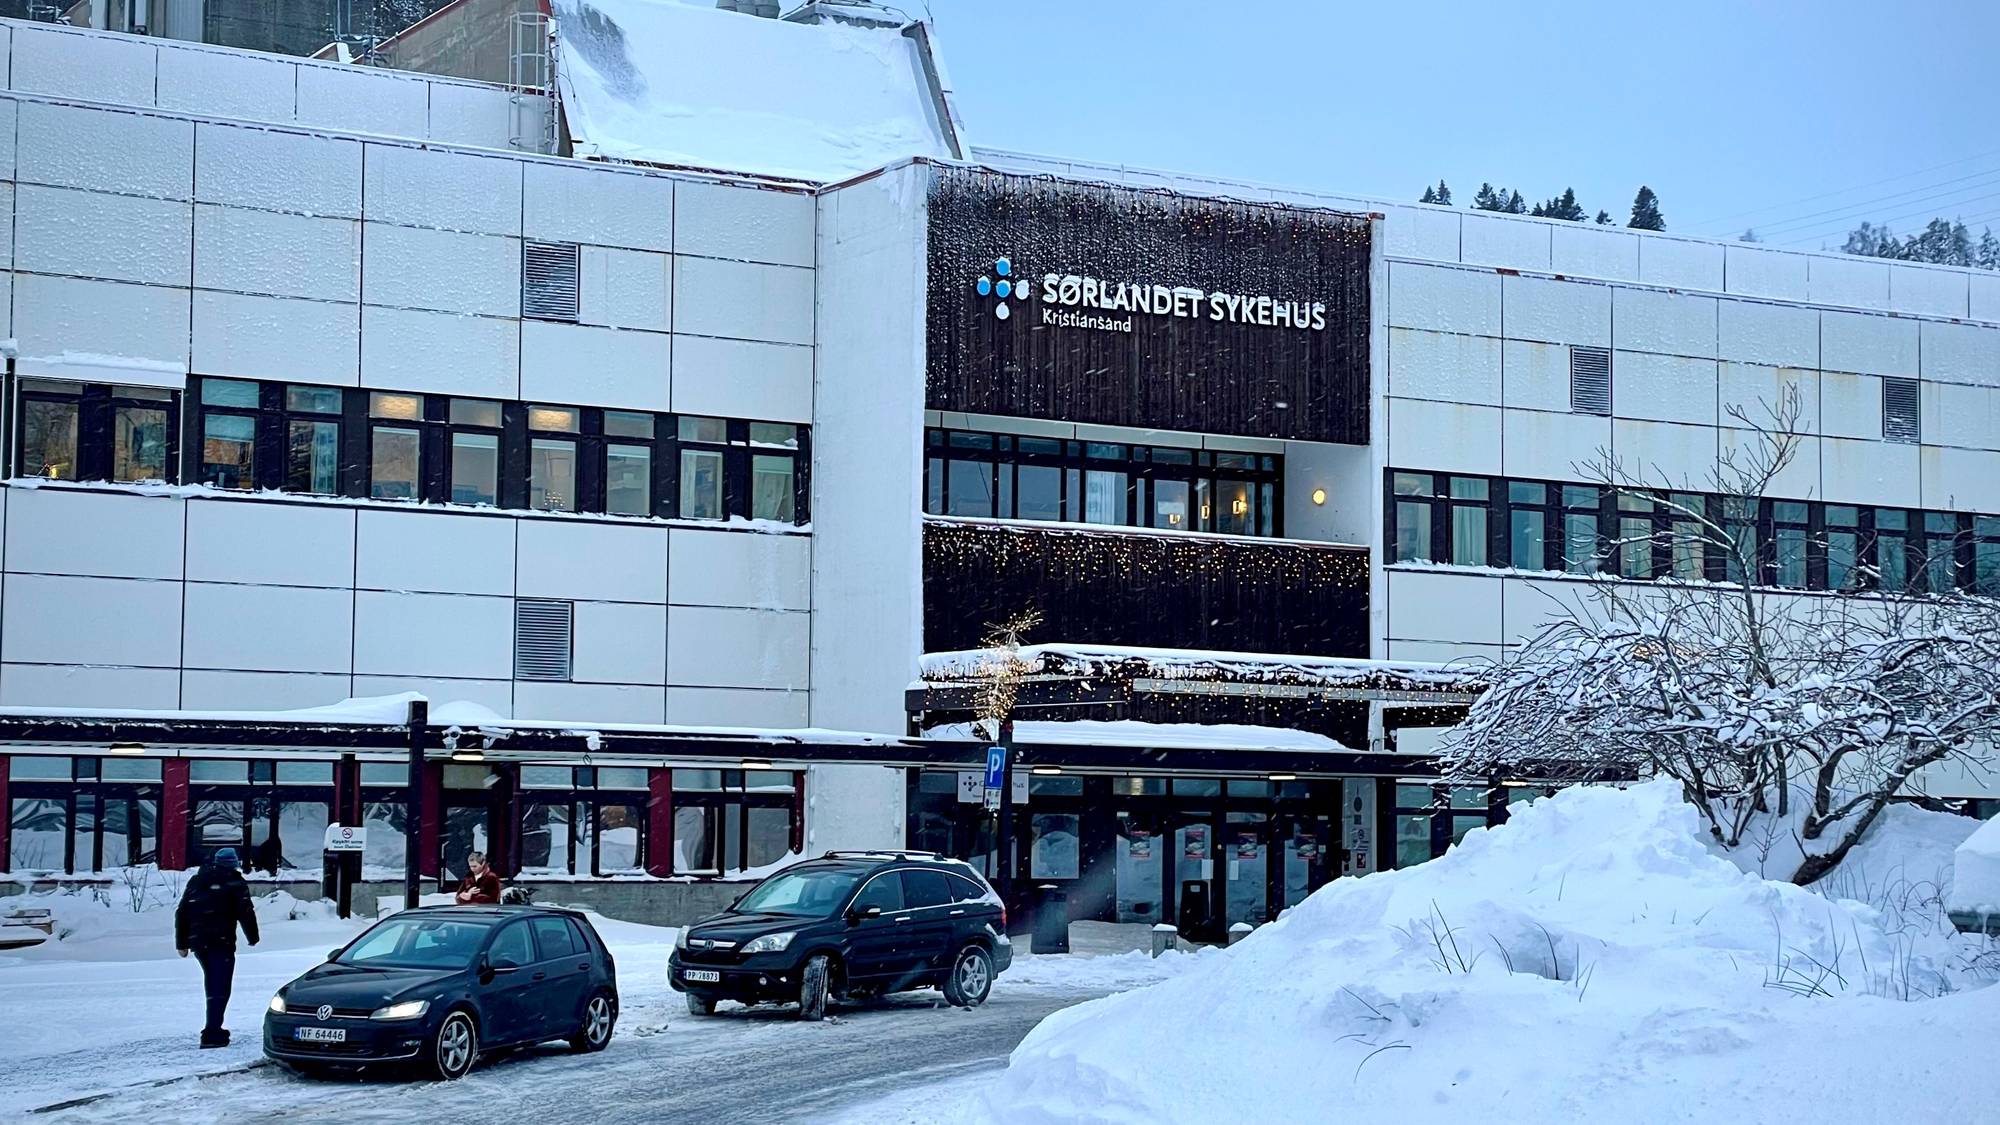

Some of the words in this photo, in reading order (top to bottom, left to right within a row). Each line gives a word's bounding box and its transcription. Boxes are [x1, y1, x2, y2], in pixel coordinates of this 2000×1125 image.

[1042, 275, 1203, 319] SØRLANDET
[1209, 293, 1326, 330] SYKEHUS
[1042, 308, 1131, 332] Kristiansand
[990, 754, 1000, 783] P
[300, 1028, 312, 1038] NF
[315, 1030, 343, 1040] 64446
